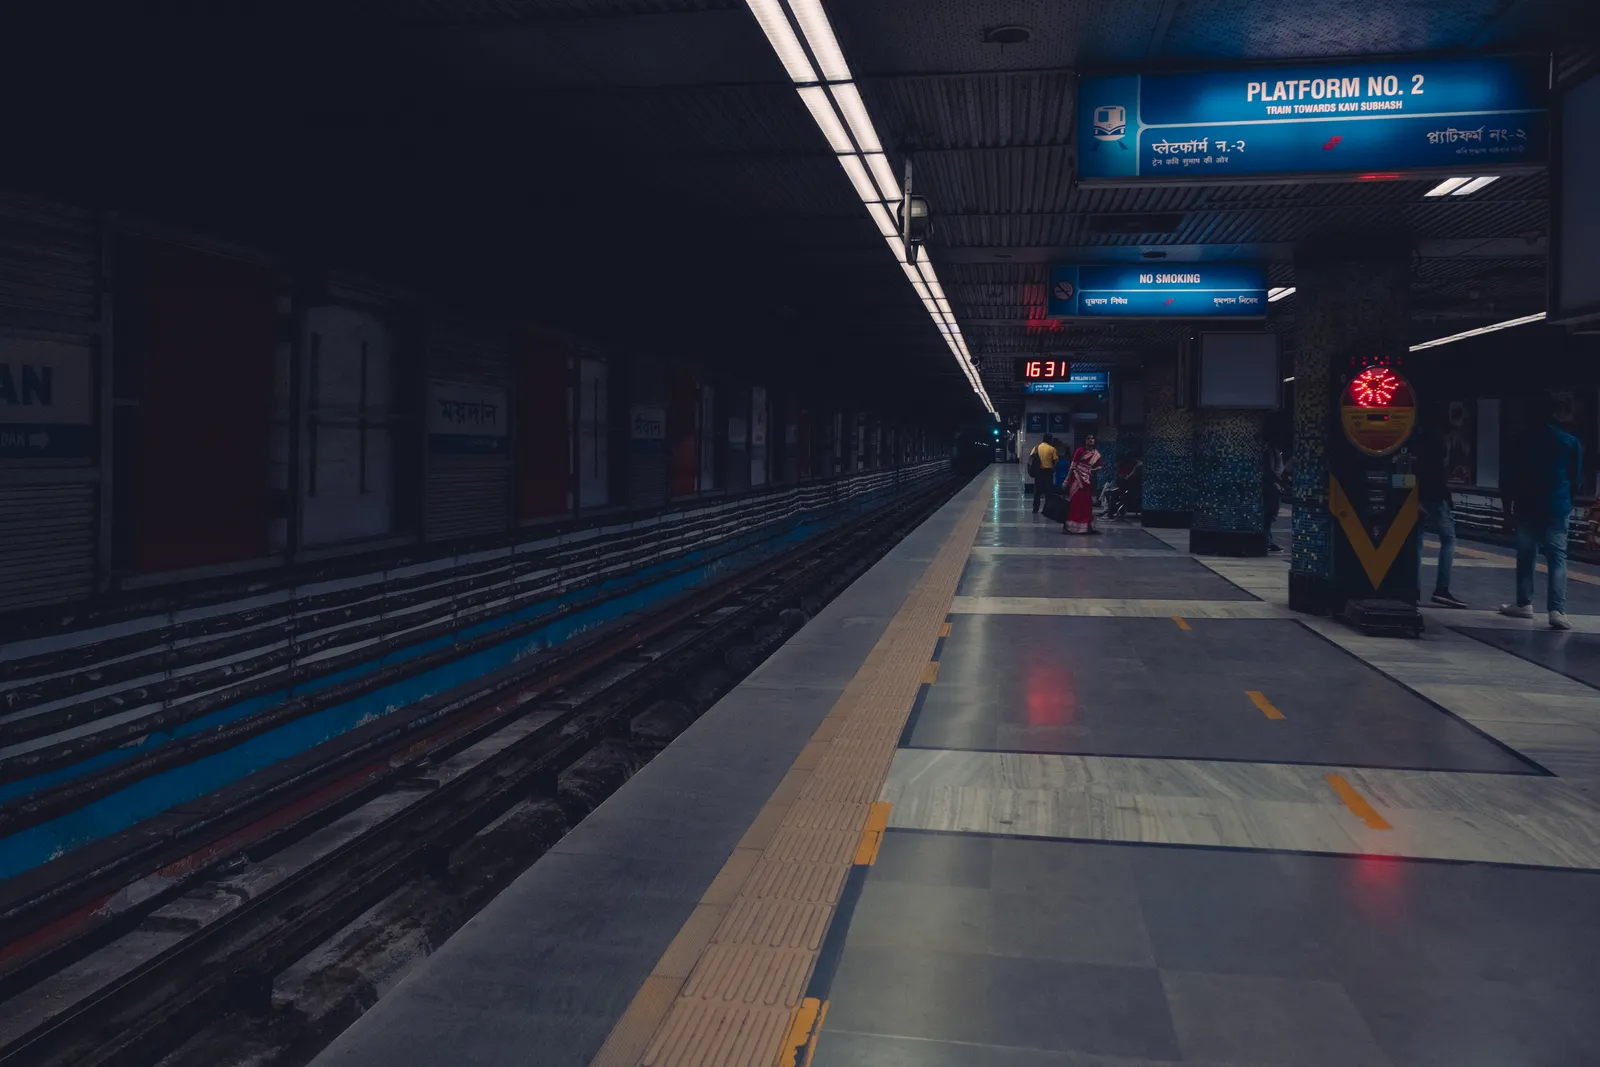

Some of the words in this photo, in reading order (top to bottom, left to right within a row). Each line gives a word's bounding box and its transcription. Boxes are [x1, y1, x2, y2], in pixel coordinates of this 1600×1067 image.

[1247, 77, 1360, 103] PLATFORM
[1367, 75, 1403, 97] NO.
[1410, 74, 1425, 95] 2
[1266, 105, 1291, 115] TRAIN
[1293, 103, 1336, 114] TOWARDS
[1338, 102, 1358, 112] KAVI
[1360, 100, 1403, 111] SUBHASH
[1151, 137, 1208, 155] प्लेटफॉर्म
[1139, 273, 1153, 284] NO
[1155, 273, 1201, 284] SMOKING
